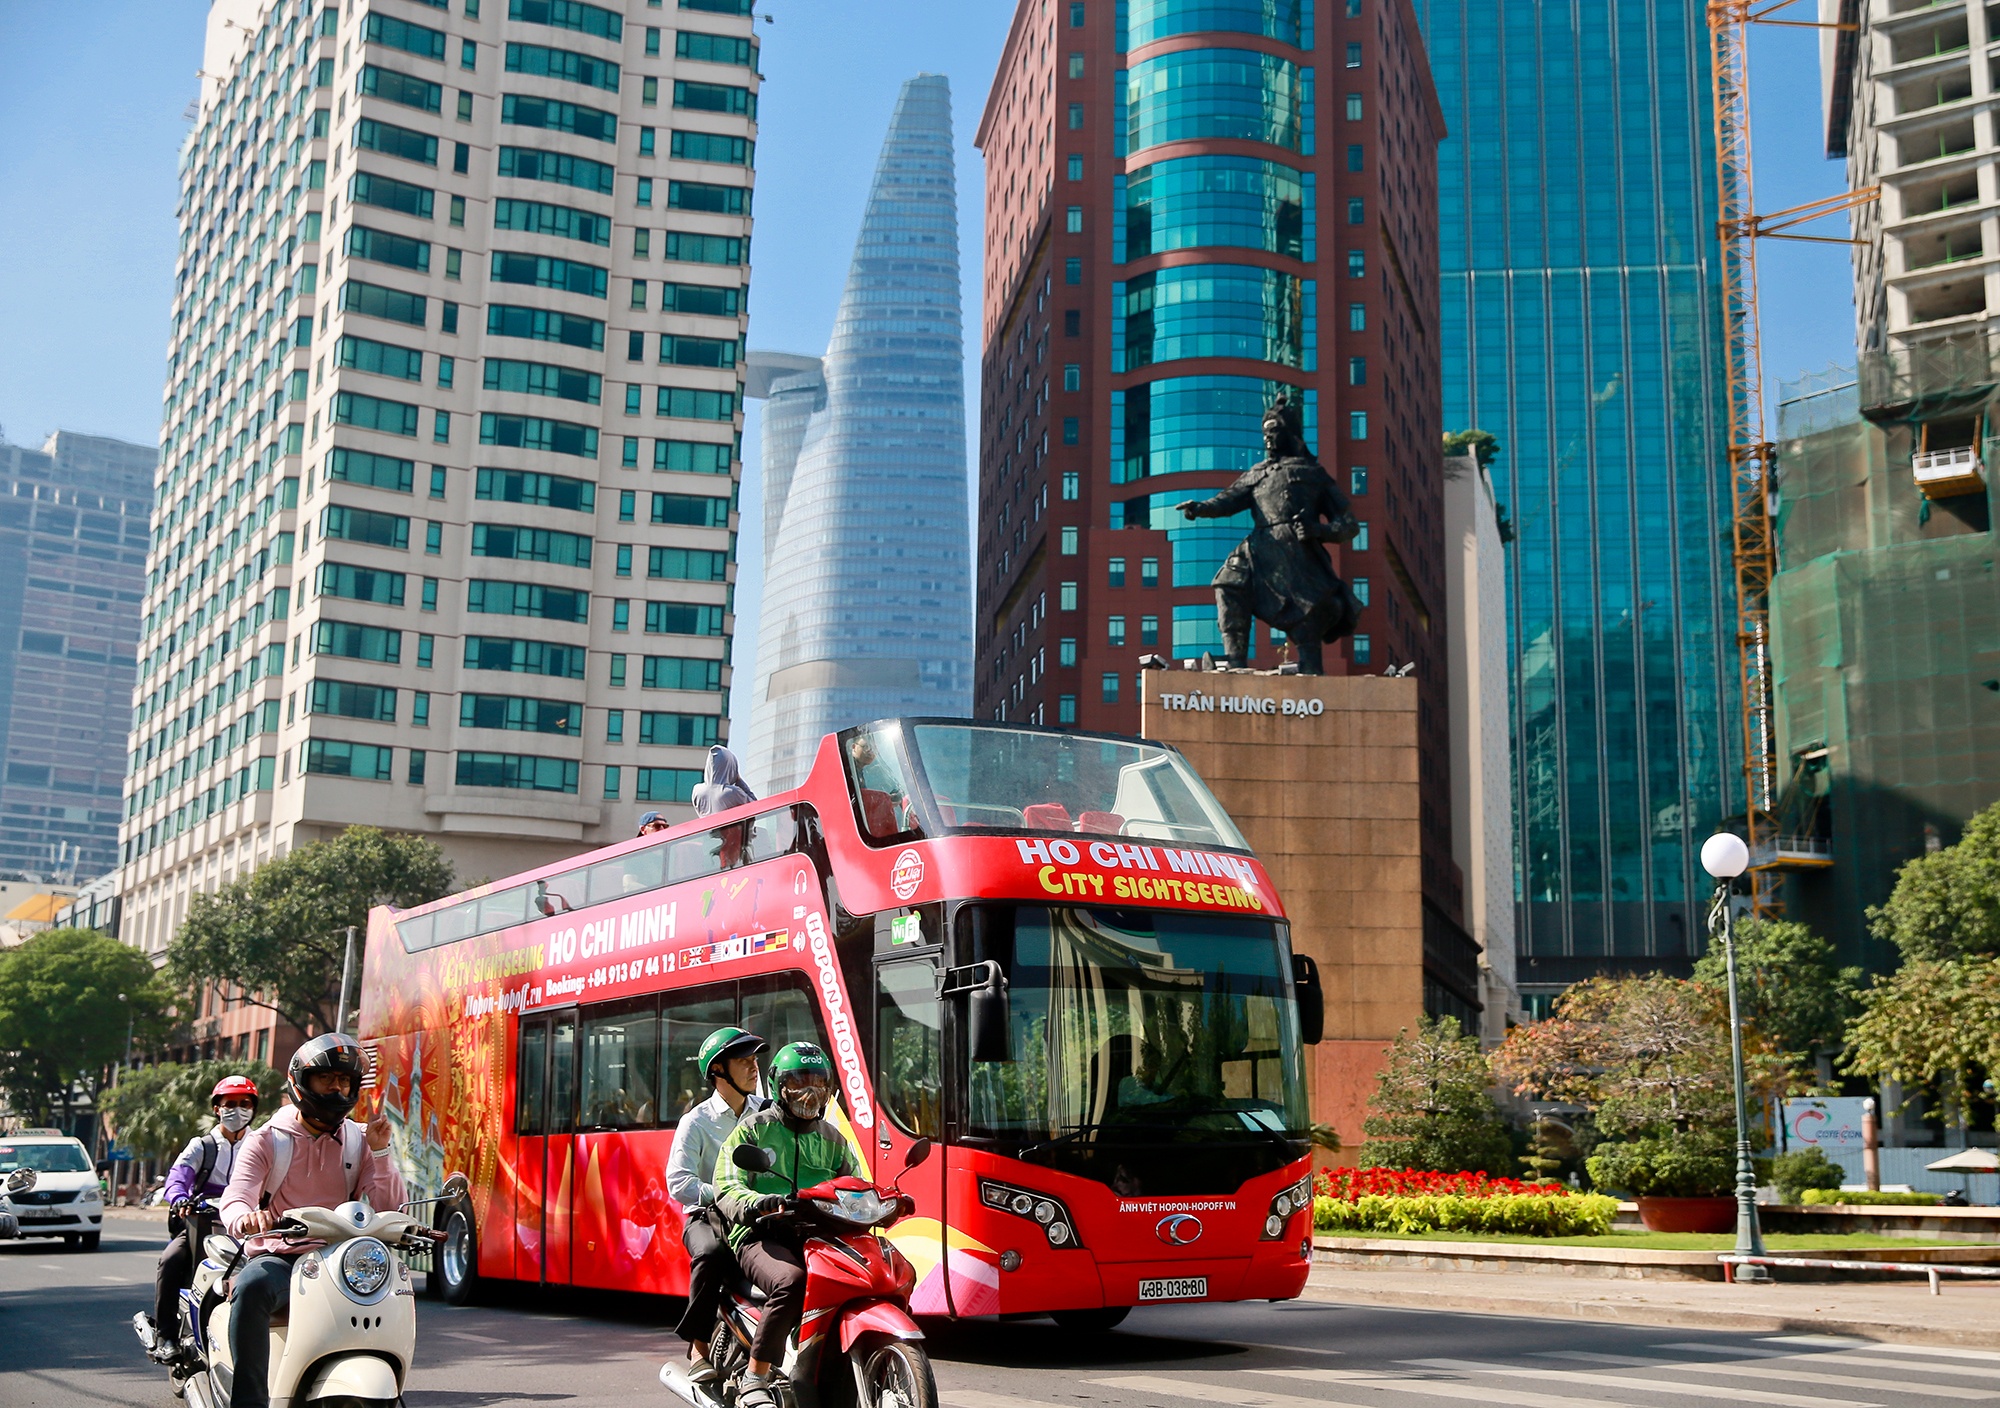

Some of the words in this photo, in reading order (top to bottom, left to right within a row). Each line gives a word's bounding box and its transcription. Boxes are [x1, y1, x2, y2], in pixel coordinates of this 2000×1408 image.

[1160, 689, 1215, 712] TRẦN
[1220, 694, 1276, 715] HƯNG
[1281, 698, 1324, 719] ĐẠO
[1015, 839, 1080, 865] HO
[1089, 841, 1160, 871] CHI
[1163, 848, 1259, 884] MINH
[1114, 875, 1262, 911] SIGHTSEEING
[548, 927, 577, 967] HO
[580, 917, 616, 959] CHI
[620, 901, 677, 950] MINH
[545, 974, 586, 997] Booking:
[588, 966, 607, 988] +84
[608, 962, 628, 984] 913
[629, 959, 645, 980] 67
[645, 955, 660, 977] 44
[662, 952, 676, 973] 12
[806, 912, 874, 1128] HOPON-HOPOFF
[800, 1055, 823, 1064] Grab
[1119, 1201, 1139, 1213] ẢNH
[1140, 1201, 1158, 1215] VIỆT
[1159, 1202, 1224, 1212] HOPON-HOPOFF
[1225, 1201, 1236, 1210] VN
